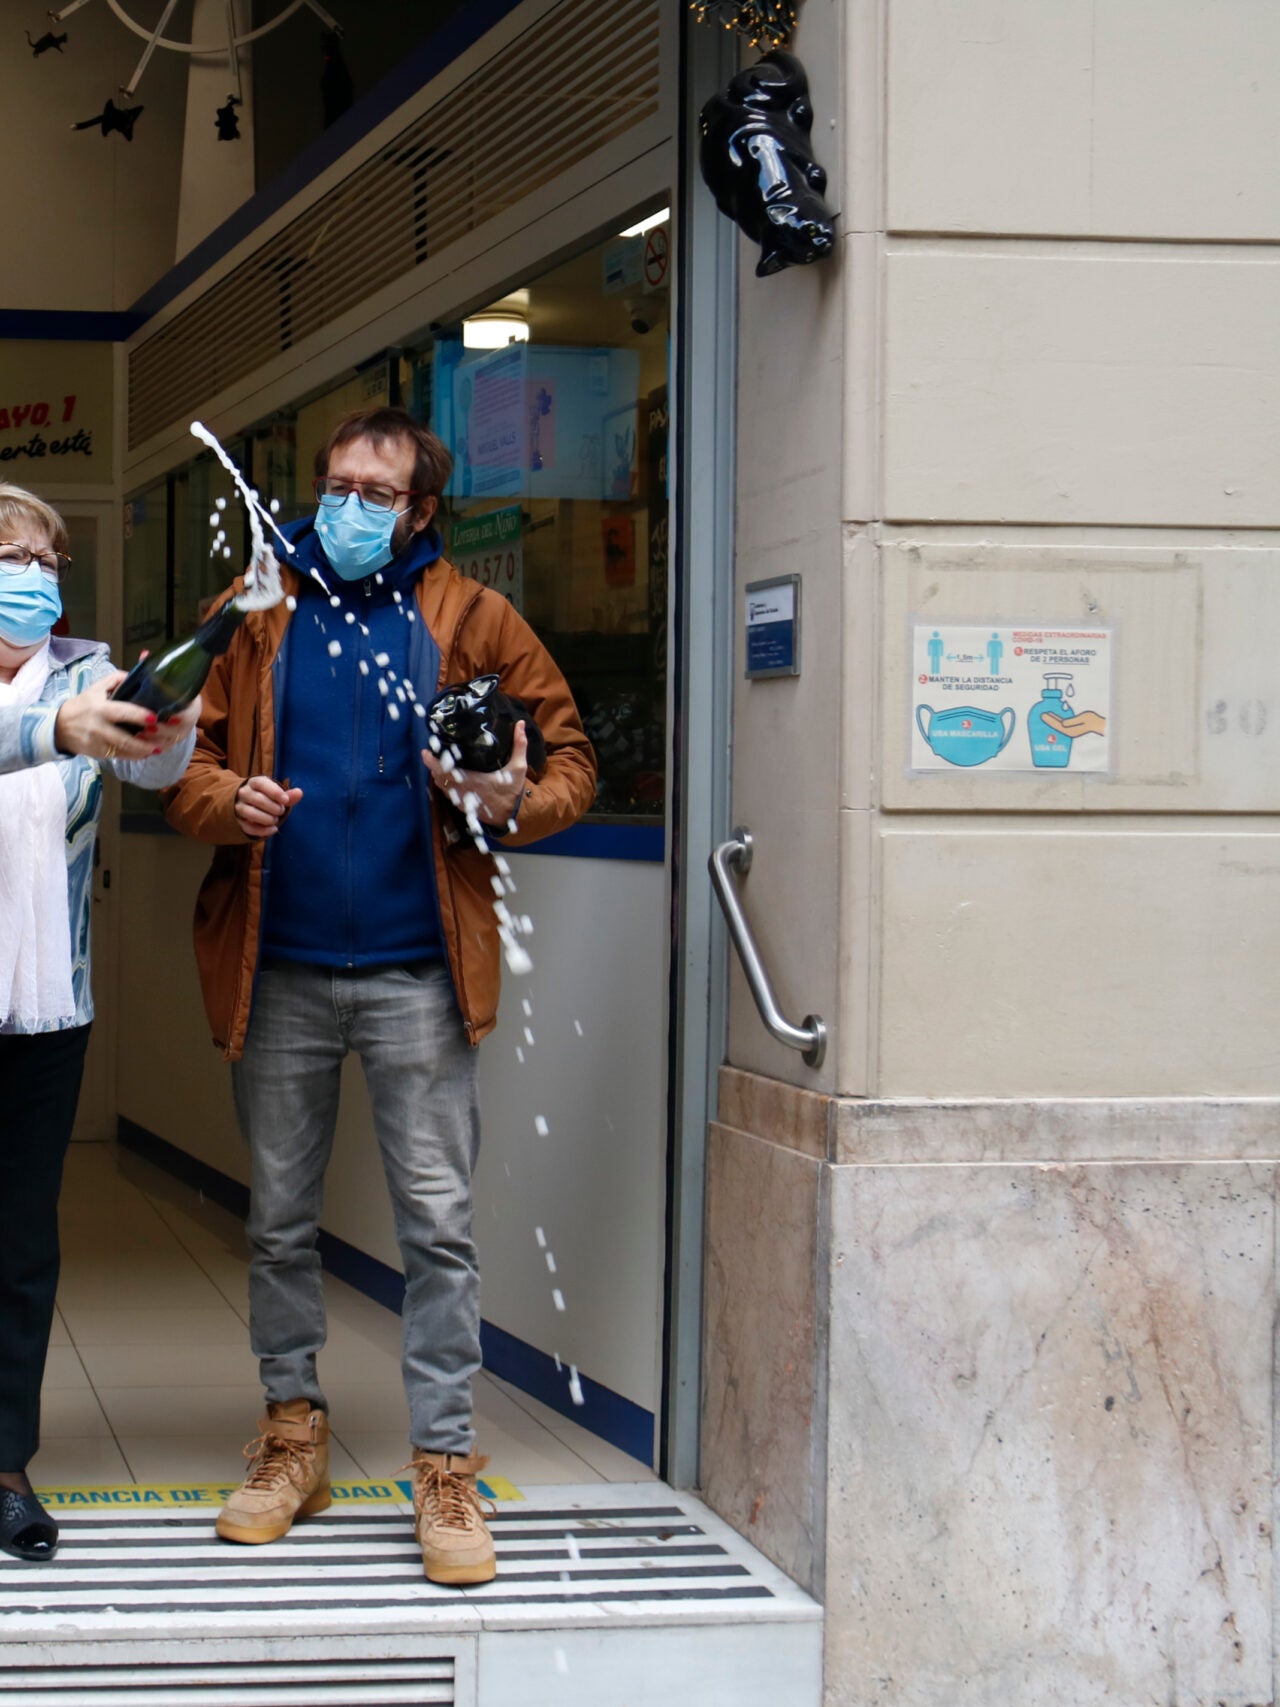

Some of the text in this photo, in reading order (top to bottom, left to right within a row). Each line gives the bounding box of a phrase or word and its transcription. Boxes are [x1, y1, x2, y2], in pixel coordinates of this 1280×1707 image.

[62, 395, 77, 423] 1
[49, 428, 93, 456] está
[1024, 648, 1058, 656] RESPETA
[1048, 656, 1090, 664] PERSONAS
[961, 676, 971, 684] LA
[973, 676, 1013, 684] DISTANCIA
[950, 730, 999, 738] MASCARILLA
[36, 1489, 163, 1505] STANCIA
[169, 1489, 213, 1502] DE
